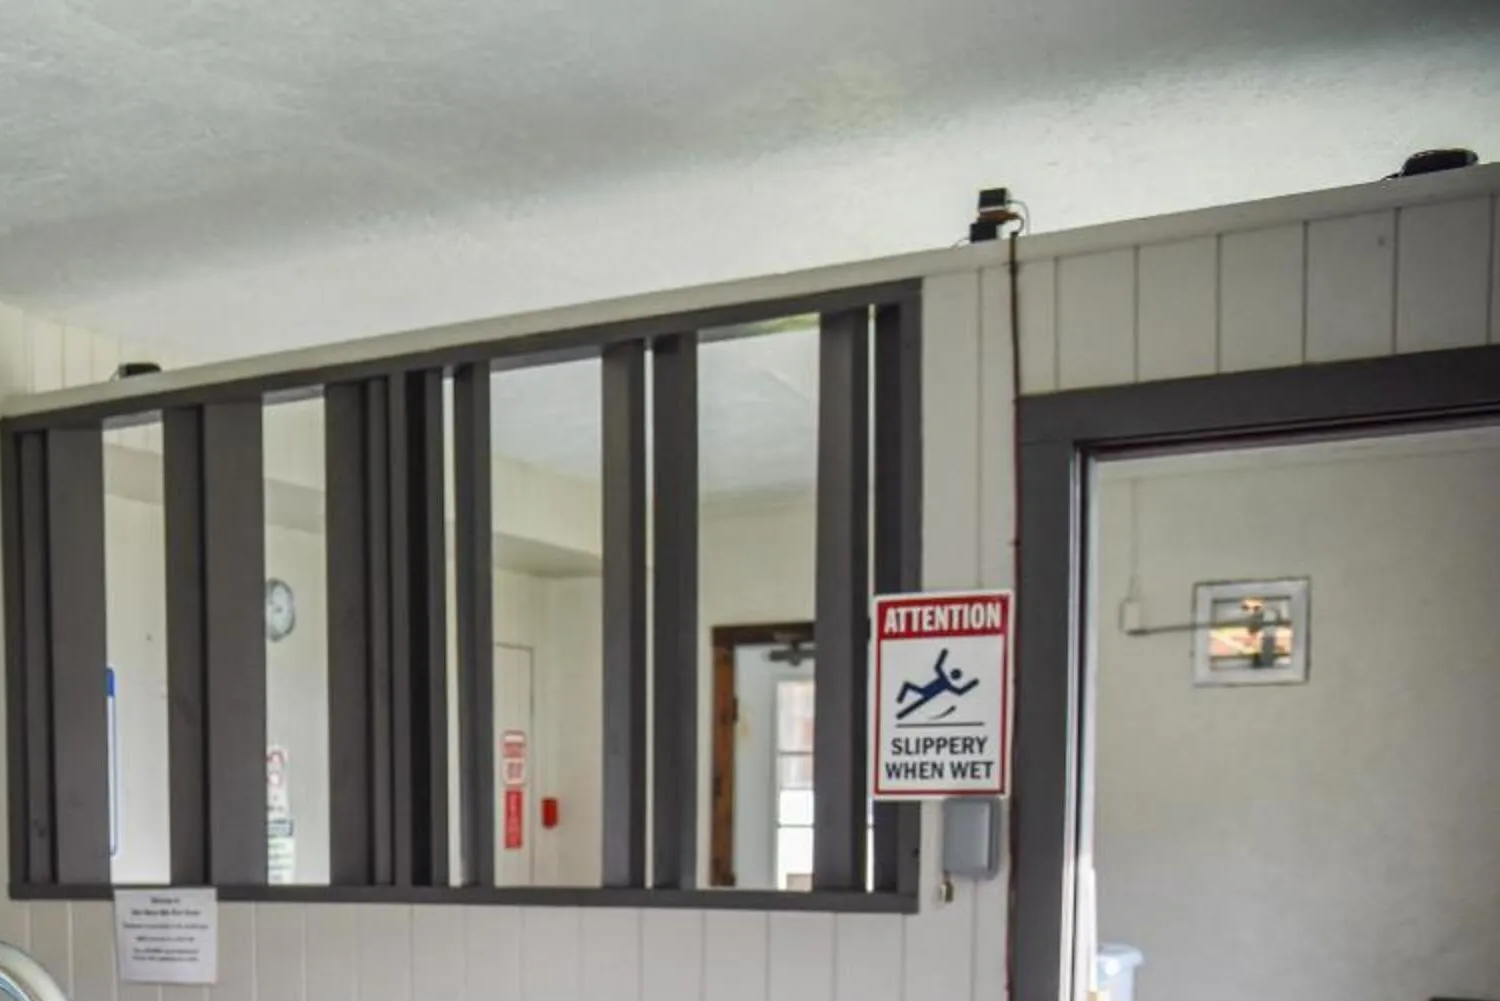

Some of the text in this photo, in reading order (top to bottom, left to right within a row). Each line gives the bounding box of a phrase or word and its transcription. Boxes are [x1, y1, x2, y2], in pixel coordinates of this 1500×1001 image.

[884, 602, 1001, 634] ATTENTION
[890, 736, 989, 756] SLIPPERY
[885, 761, 995, 780] WHEN WET
